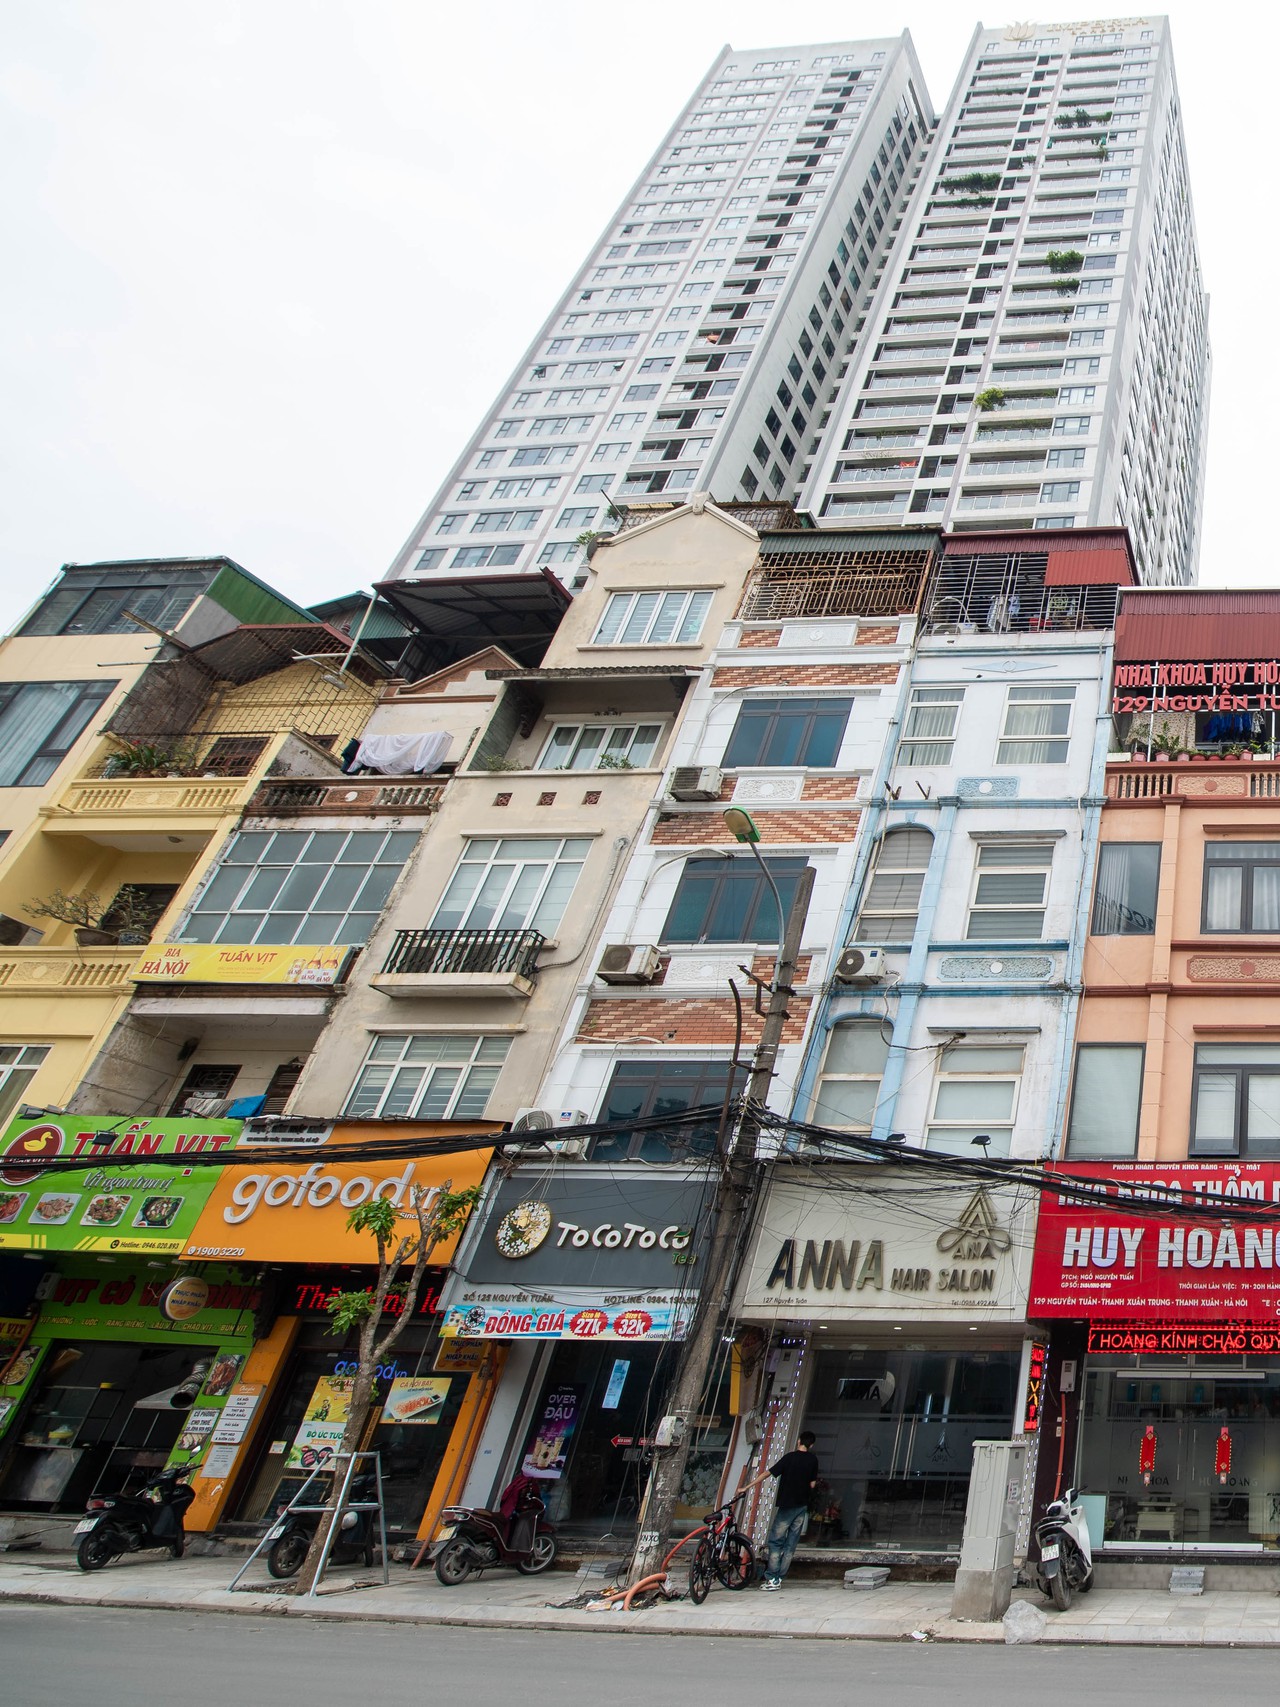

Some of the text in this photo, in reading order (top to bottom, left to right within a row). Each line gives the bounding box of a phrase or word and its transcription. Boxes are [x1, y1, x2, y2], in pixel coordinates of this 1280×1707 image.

[1114, 664, 1152, 686] NHA
[1158, 663, 1207, 685] KHOA
[1212, 662, 1248, 684] HUY
[1113, 696, 1148, 713] 129
[1153, 684, 1248, 712] NGUYỄN
[164, 948, 181, 957] BIA
[218, 949, 278, 965] TUẤN VỊT
[139, 961, 190, 978] HÀ NỘI
[101, 1177, 133, 1192] ngon
[1193, 1169, 1264, 1206] THẨM
[120, 1241, 140, 1249] Hotline:
[1062, 1227, 1145, 1269] HUY
[767, 1239, 995, 1292] ANNA HAIR SALON
[463, 1291, 475, 1301] SỐ
[604, 1295, 645, 1304] HOTLINE:
[1148, 1298, 1170, 1306] TRUNG
[536, 1309, 565, 1332] GIÁ
[574, 1319, 646, 1335] 27k 32k
[1100, 1331, 1157, 1348] HOÀNG
[1161, 1331, 1198, 1348] KÍNH
[549, 1395, 576, 1404] OVER
